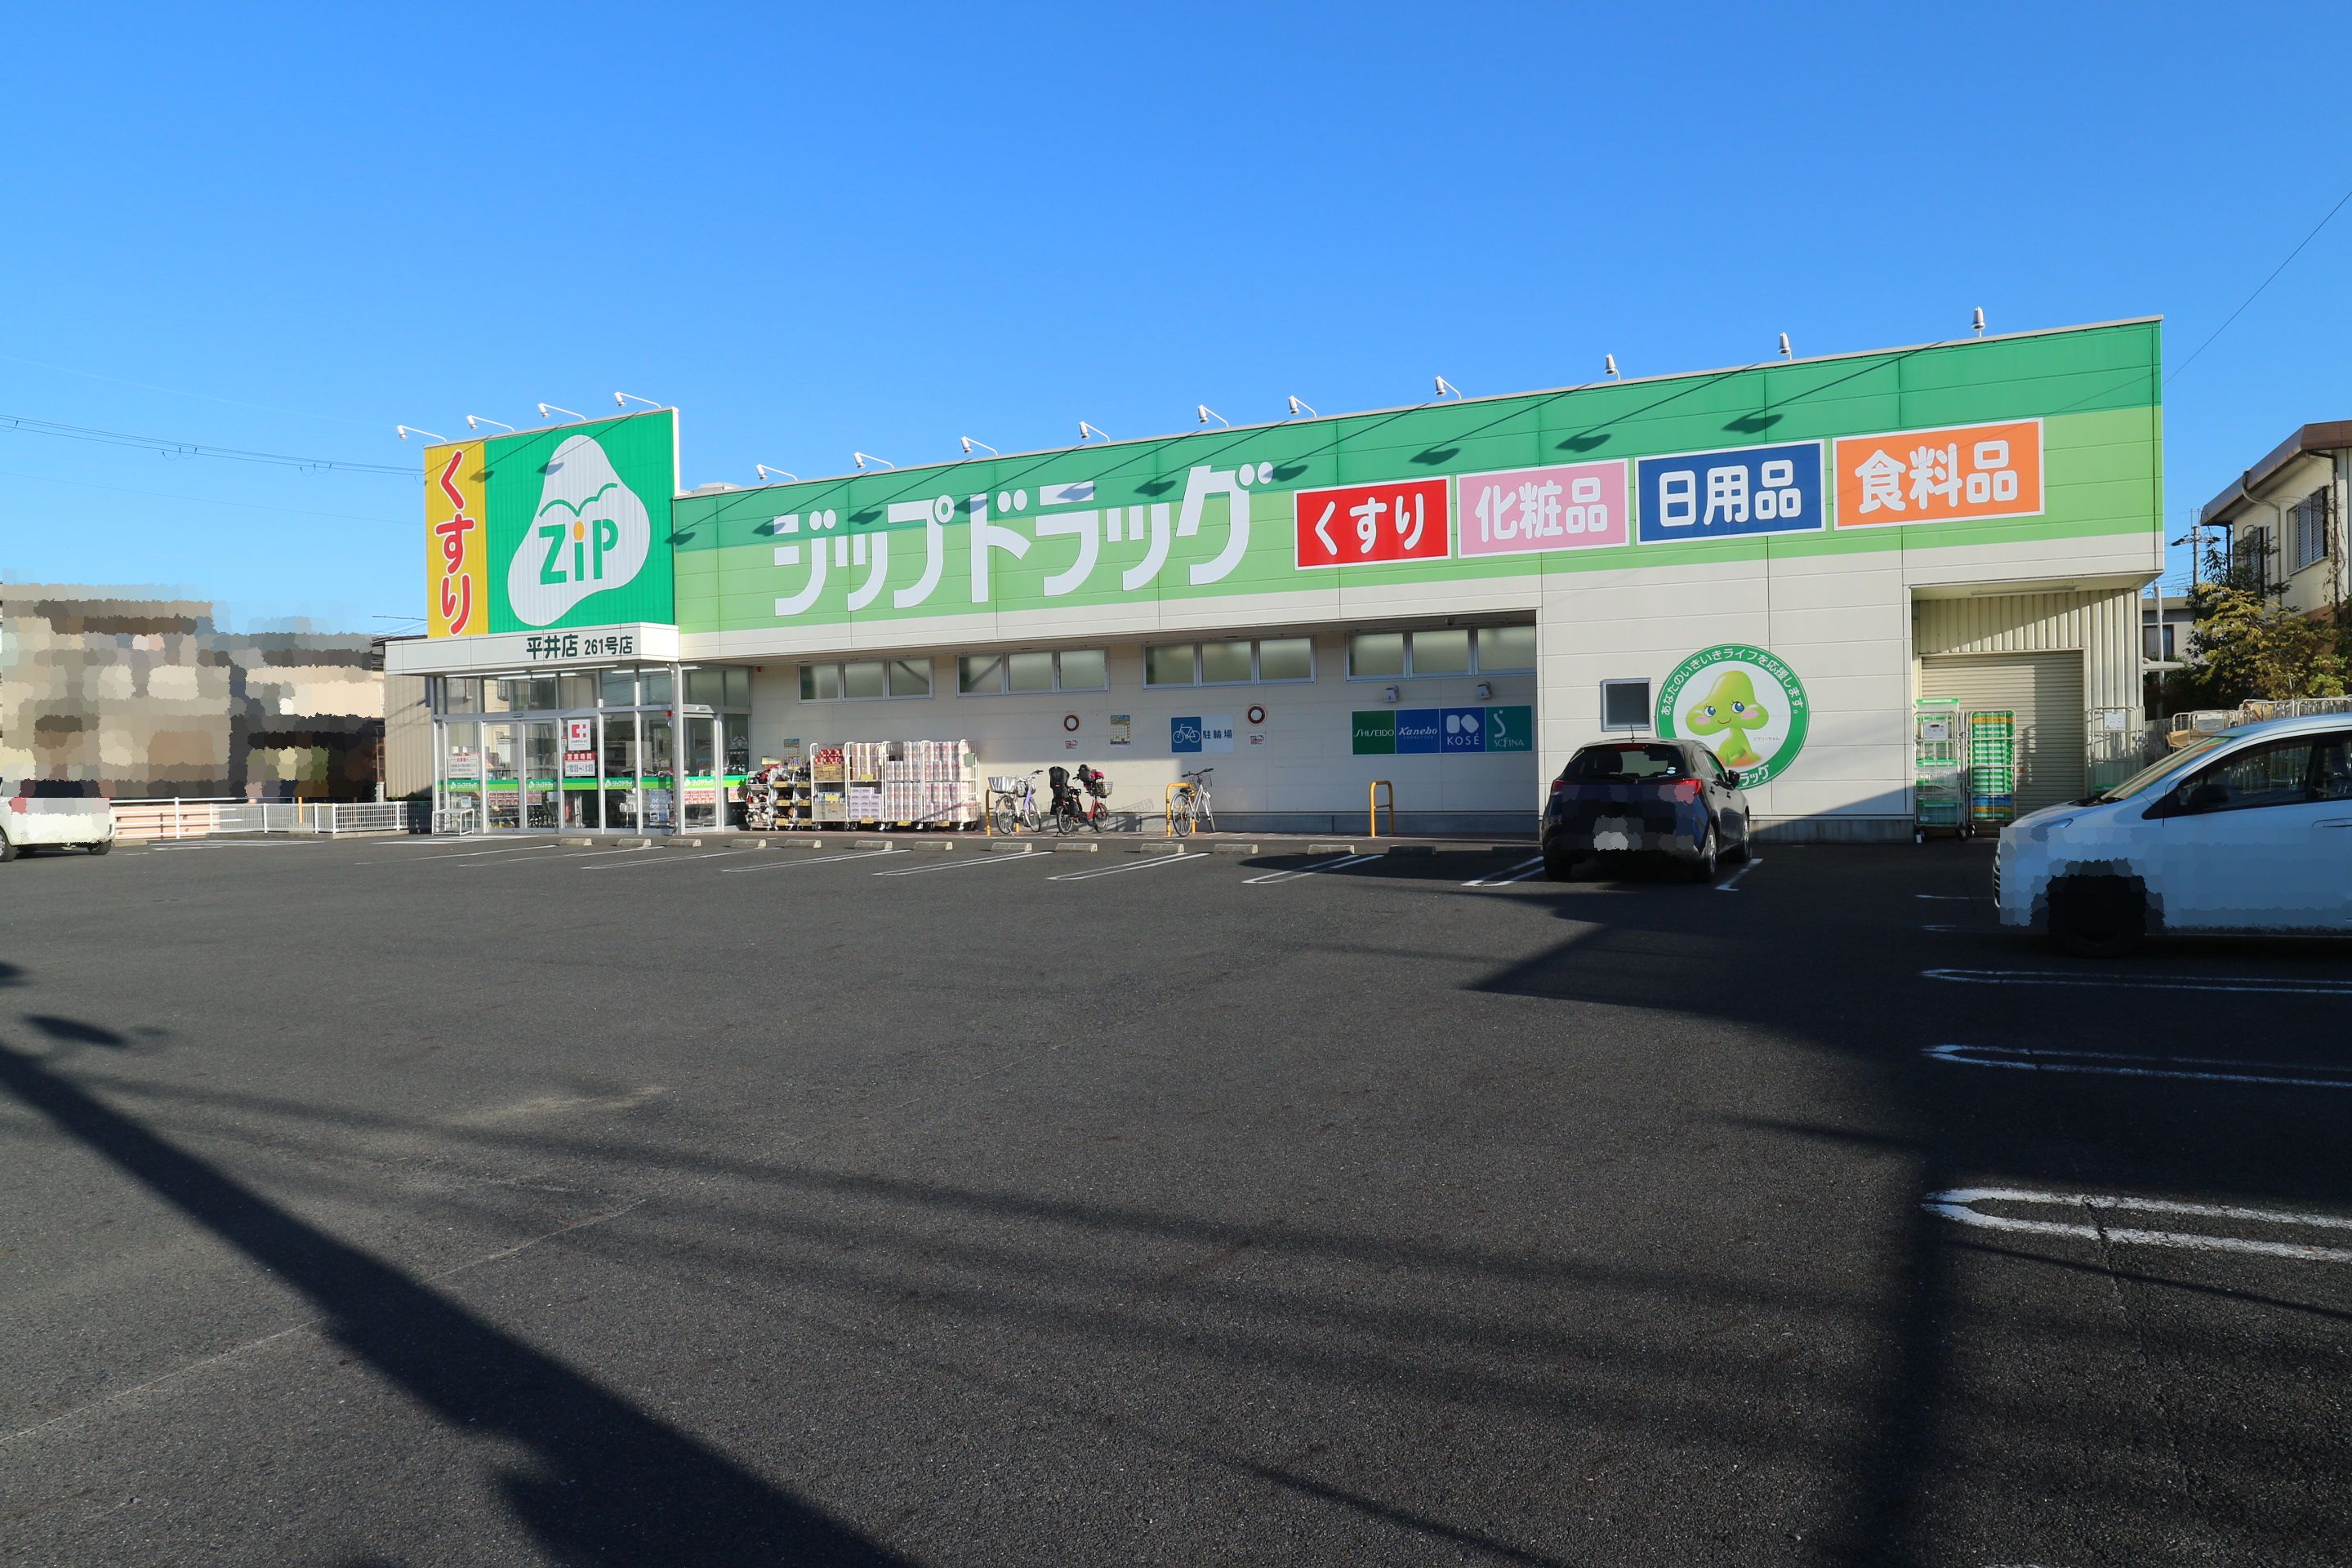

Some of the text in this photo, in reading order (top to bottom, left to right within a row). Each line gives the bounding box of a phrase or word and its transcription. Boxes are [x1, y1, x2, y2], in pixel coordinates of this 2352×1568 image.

[1659, 459, 1802, 528] 日用品
[1855, 439, 2018, 514] 食料品
[1314, 492, 1424, 555] くすり
[1475, 477, 1608, 542] 化粧品
[435, 450, 474, 635] くすり
[773, 461, 1274, 617] ジップドラッグ
[526, 634, 633, 660] 平井店 261号店
[1202, 729, 1232, 739] 駐輪場
[1354, 729, 1395, 737] SHISEIDO
[1398, 726, 1437, 736] Kanebo
[1494, 737, 1525, 747] SOFINA
[1739, 764, 1770, 786] ラッグ
